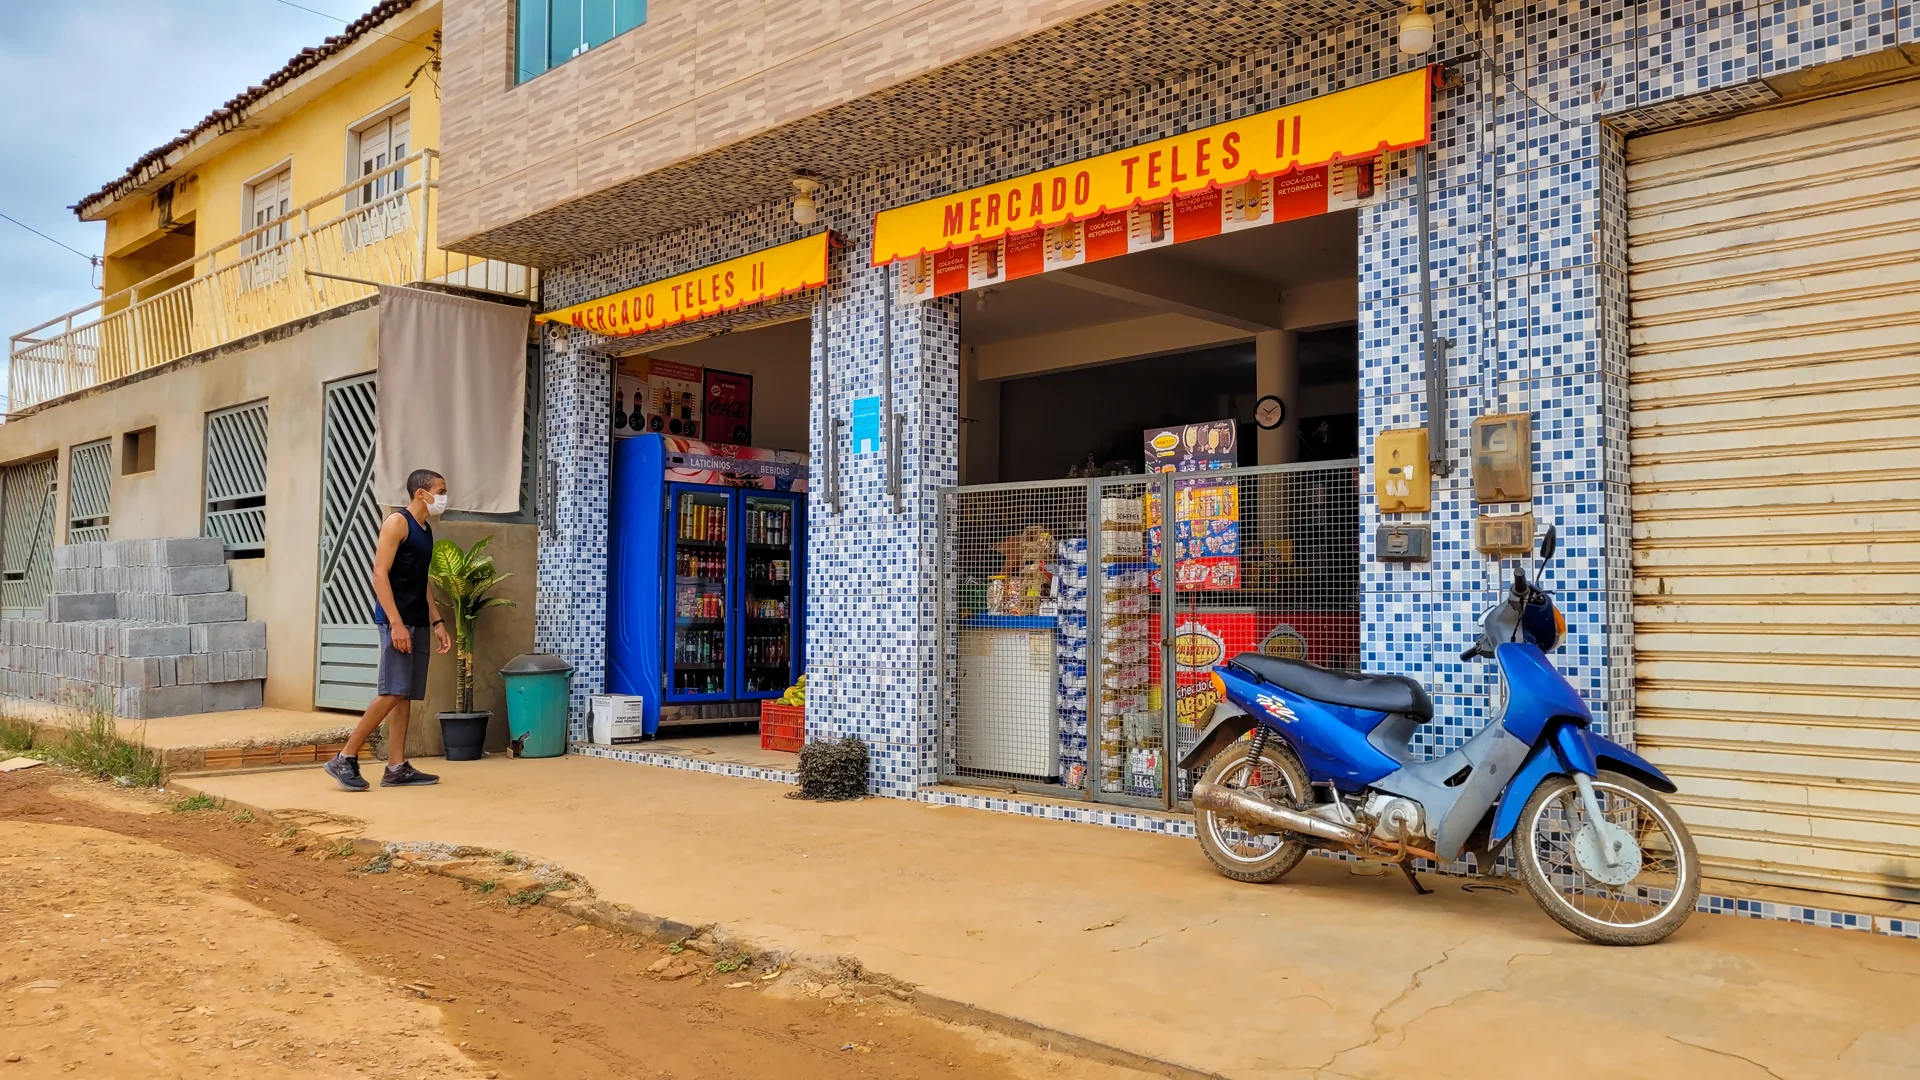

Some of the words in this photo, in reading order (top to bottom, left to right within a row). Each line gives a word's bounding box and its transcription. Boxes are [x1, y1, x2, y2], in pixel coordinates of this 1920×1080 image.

[943, 171, 1091, 238] MERCADO
[1121, 130, 1241, 191] TELES
[1275, 115, 1301, 160] II
[1280, 173, 1320, 187] COCA-COLA
[1278, 181, 1323, 196] RETORNÁVEL
[1176, 197, 1201, 207] MELHOR
[1201, 193, 1218, 202] PARA
[1089, 218, 1121, 231] COCA-COLA
[1088, 226, 1124, 239] RETORNÁVEL
[936, 263, 966, 275] RETORNÁVEL
[938, 257, 964, 268] COCA-COLA
[571, 292, 654, 331] MERCADO
[671, 270, 735, 312] TELES
[752, 261, 764, 292] II
[690, 457, 731, 470] LATICÍNIOS
[760, 465, 790, 476] BEBIDAS
